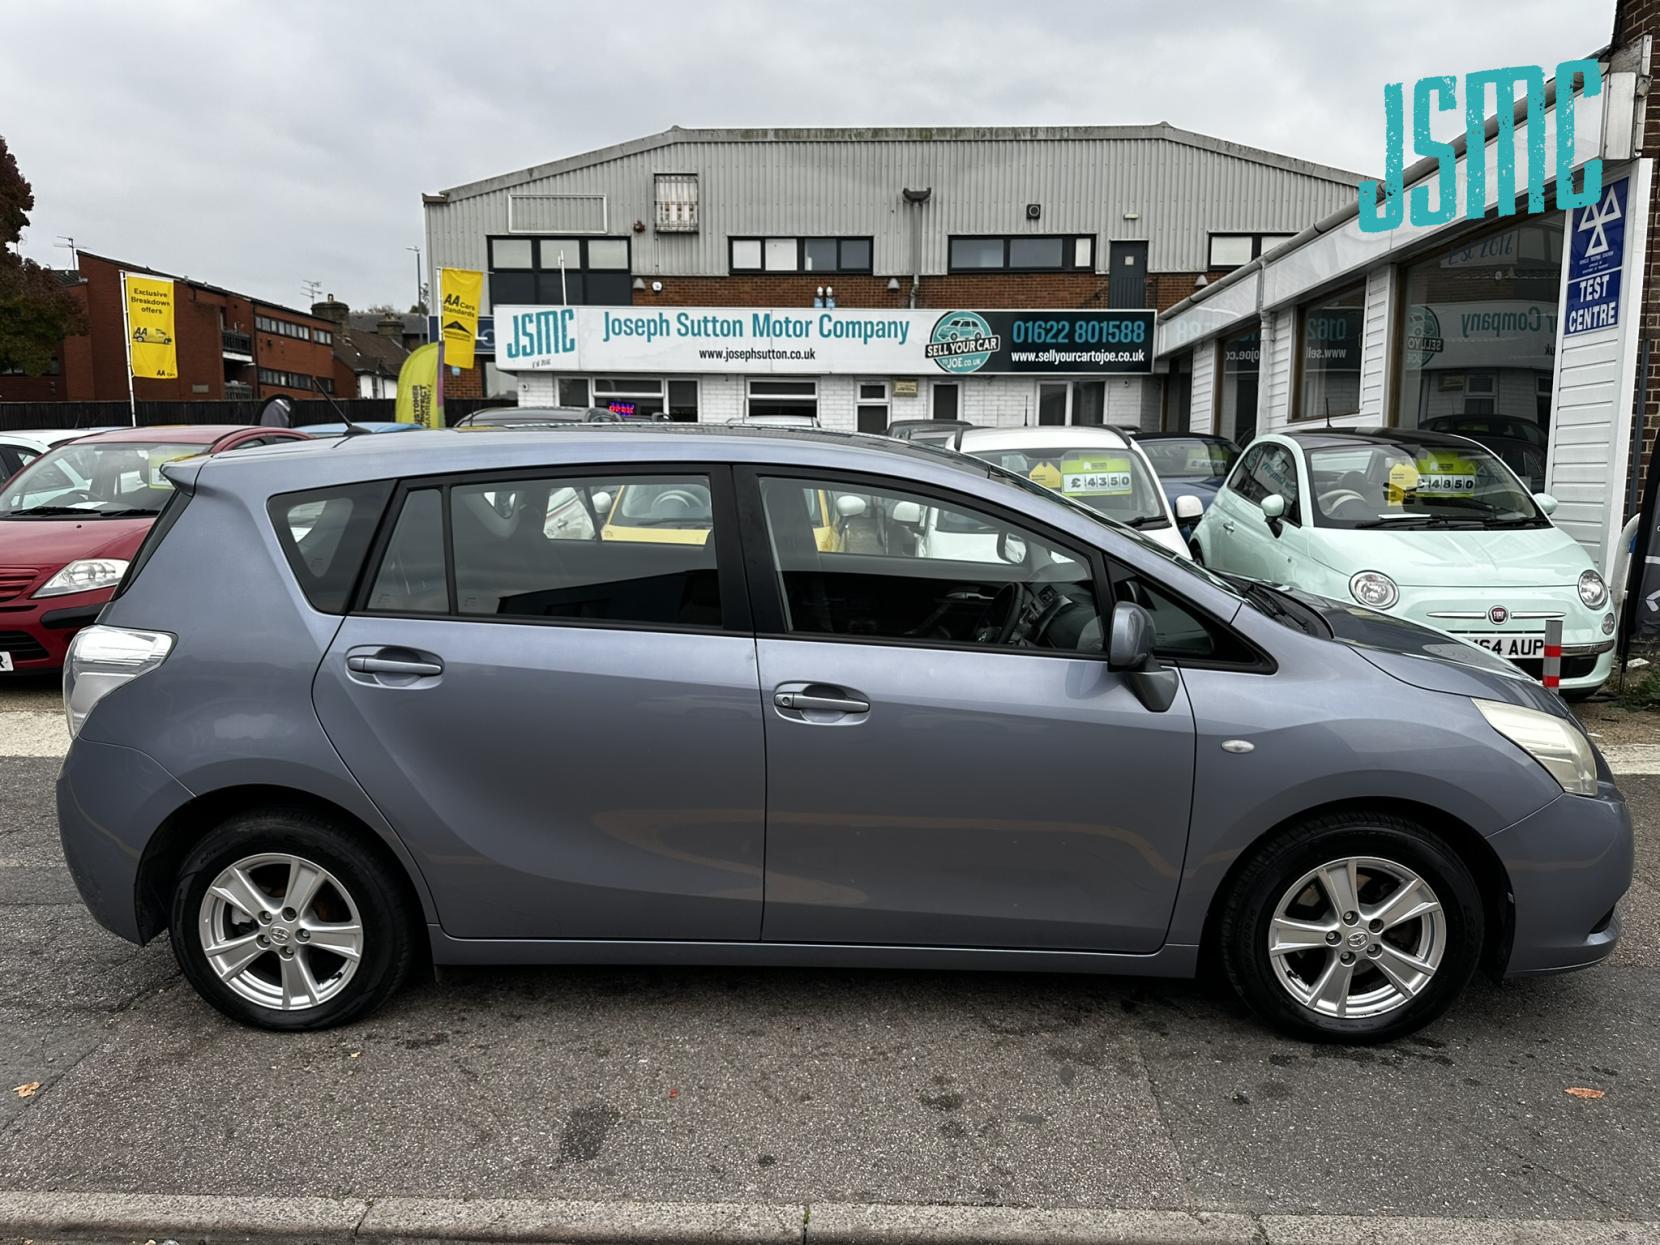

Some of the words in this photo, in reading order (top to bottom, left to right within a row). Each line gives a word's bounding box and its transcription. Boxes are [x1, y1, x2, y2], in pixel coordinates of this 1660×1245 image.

[133, 288, 168, 298] Exclusive
[1579, 274, 1610, 303] TEST
[131, 296, 171, 307] Breakdown
[443, 293, 461, 306] AA
[460, 301, 475, 311] Cars
[443, 305, 475, 318] Standards
[1568, 301, 1617, 333] CENTRE
[506, 308, 576, 359] JSMC
[602, 311, 671, 343] Joseph
[676, 312, 744, 338] Sutton
[752, 313, 813, 338] Motor
[818, 313, 911, 345] Company
[1012, 320, 1070, 343] 01622
[1074, 320, 1145, 343] 801588
[699, 347, 816, 362] www.josephsutton.co.uk
[927, 344, 949, 357] SELL
[950, 341, 976, 354] YOUR
[976, 338, 997, 351] CAR
[1011, 349, 1145, 365] www.sellyourcartojoe.co.uk
[156, 369, 166, 377] AA
[1508, 639, 1544, 656] AUP
